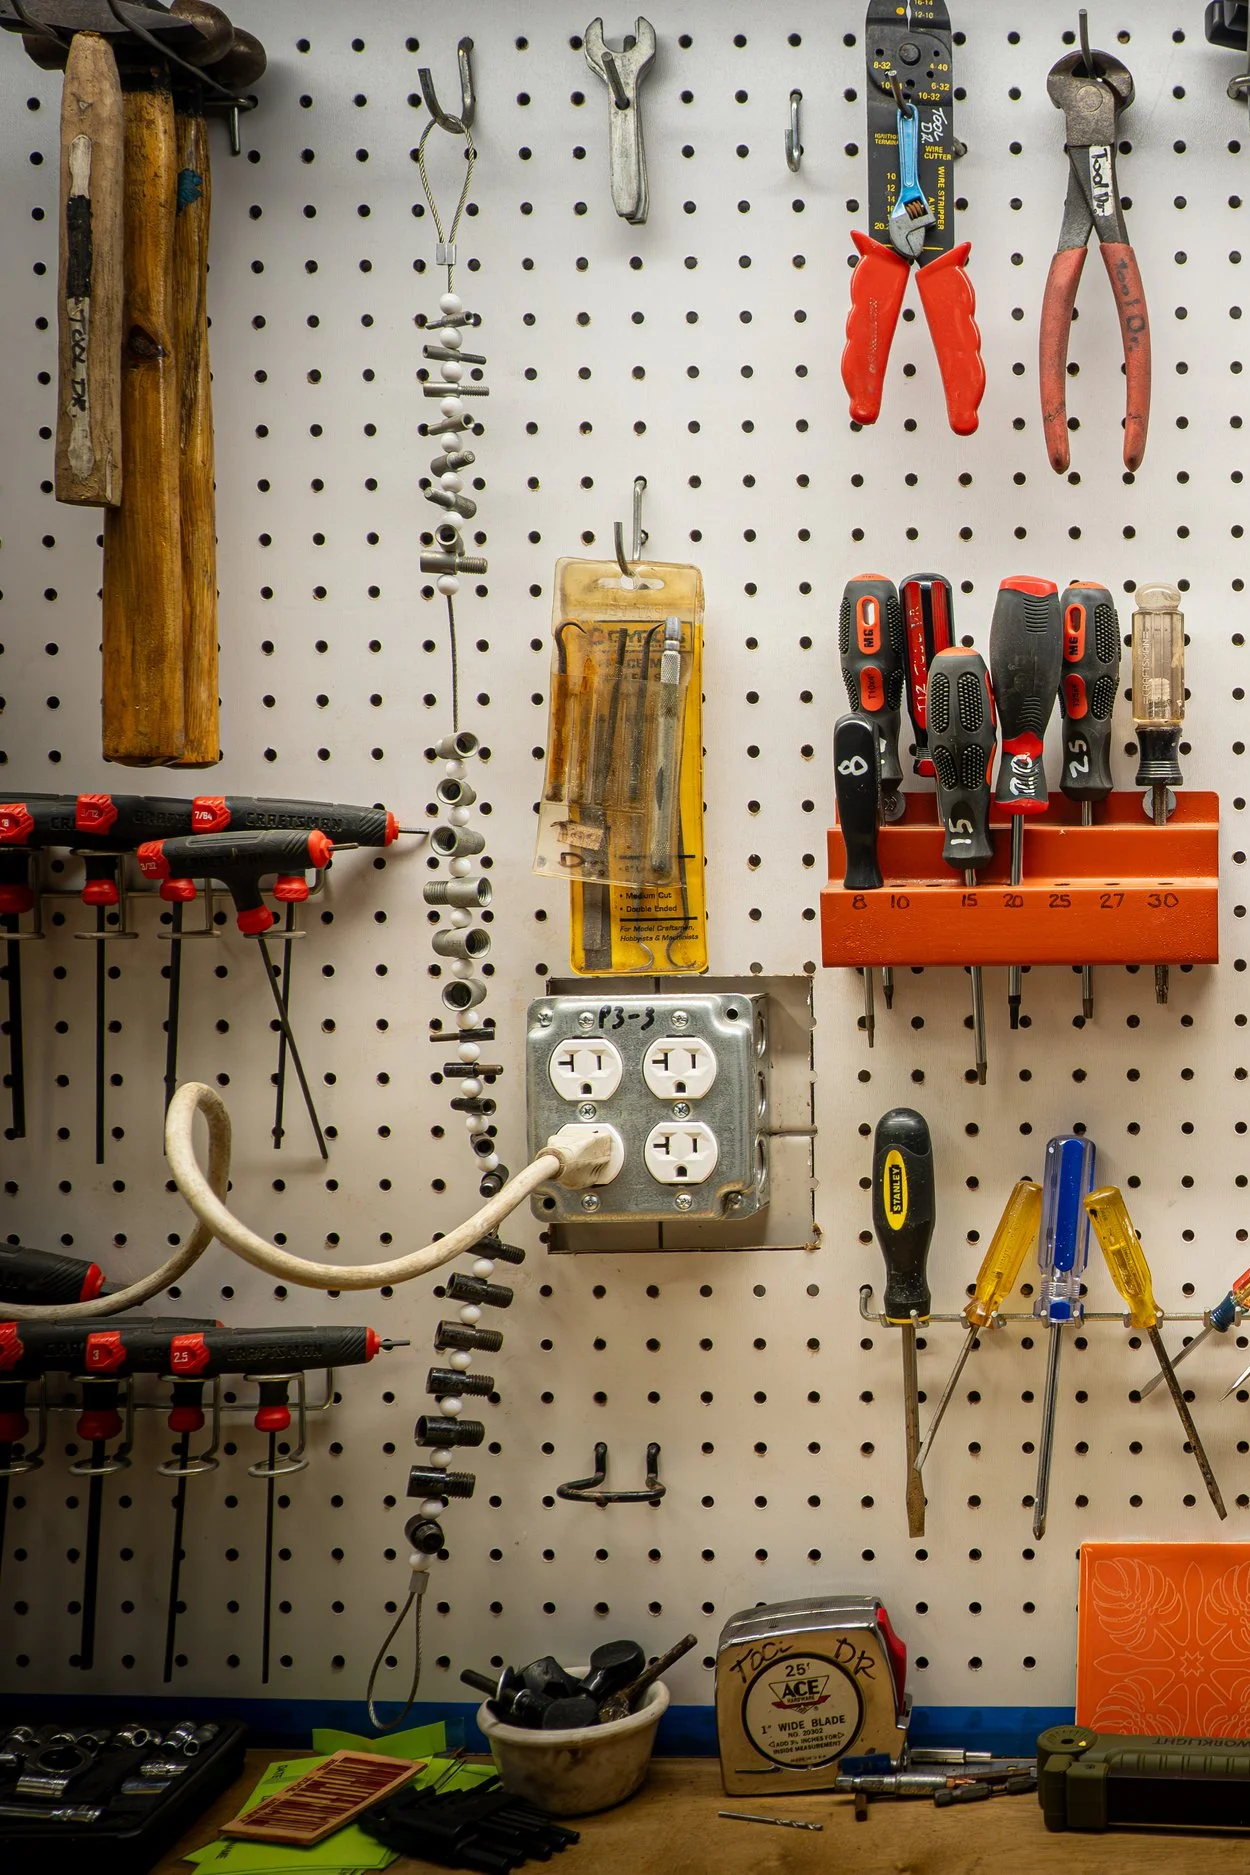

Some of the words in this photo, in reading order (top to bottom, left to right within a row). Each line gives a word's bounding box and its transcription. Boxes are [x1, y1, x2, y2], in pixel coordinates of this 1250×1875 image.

[931, 82, 950, 91] 6-32
[919, 92, 940, 100] 10-32
[925, 145, 943, 153] WIRE
[887, 172, 896, 180] 10
[887, 184, 896, 192] 12
[838, 755, 868, 776] 8
[194, 811, 213, 821] 7/64
[245, 812, 344, 832] CRAFTSMAN
[852, 894, 867, 910] 8
[890, 894, 910, 909] 10
[961, 893, 978, 907] 15
[1002, 893, 1024, 908] 20
[1049, 893, 1071, 909] 25
[1099, 893, 1125, 909] 27
[1147, 892, 1179, 909] 30
[626, 905, 653, 913] Double
[655, 933, 661, 941] &
[599, 1005, 655, 1031] P3-3
[893, 1168, 901, 1212] STANLEY
[92, 1349, 100, 1361] 3
[173, 1351, 189, 1363] 2.5
[833, 1637, 876, 1680] DR
[785, 1662, 811, 1678] 25'
[782, 1679, 821, 1699] ACE
[778, 1720, 806, 1732] WIDE
[811, 1714, 847, 1728] BLADE
[803, 1727, 824, 1736] 20302
[773, 1746, 794, 1755] INSIDE
[795, 1740, 842, 1753] MEASUREMENT
[775, 1740, 789, 1748] ADD
[801, 1736, 824, 1744] INCHES
